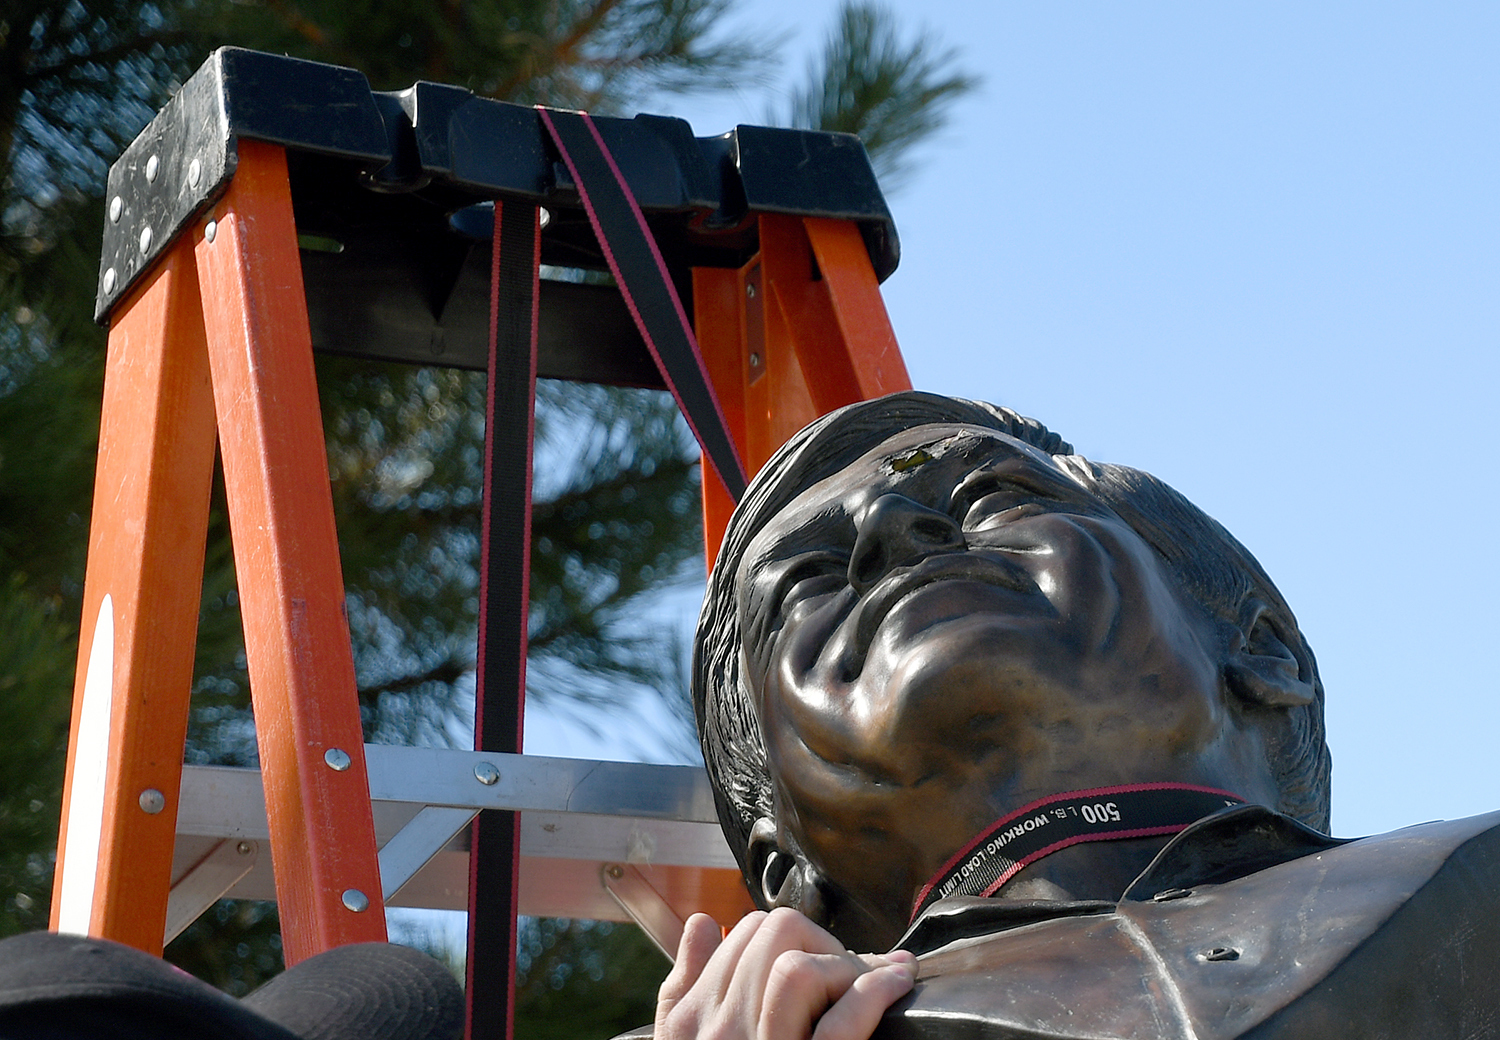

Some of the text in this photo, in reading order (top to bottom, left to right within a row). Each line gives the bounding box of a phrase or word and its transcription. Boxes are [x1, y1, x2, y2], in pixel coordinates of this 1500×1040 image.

[1081, 802, 1121, 824] 500
[986, 813, 1050, 855] WORKING
[961, 851, 986, 877] LOAD
[939, 872, 962, 899] LIMIT
